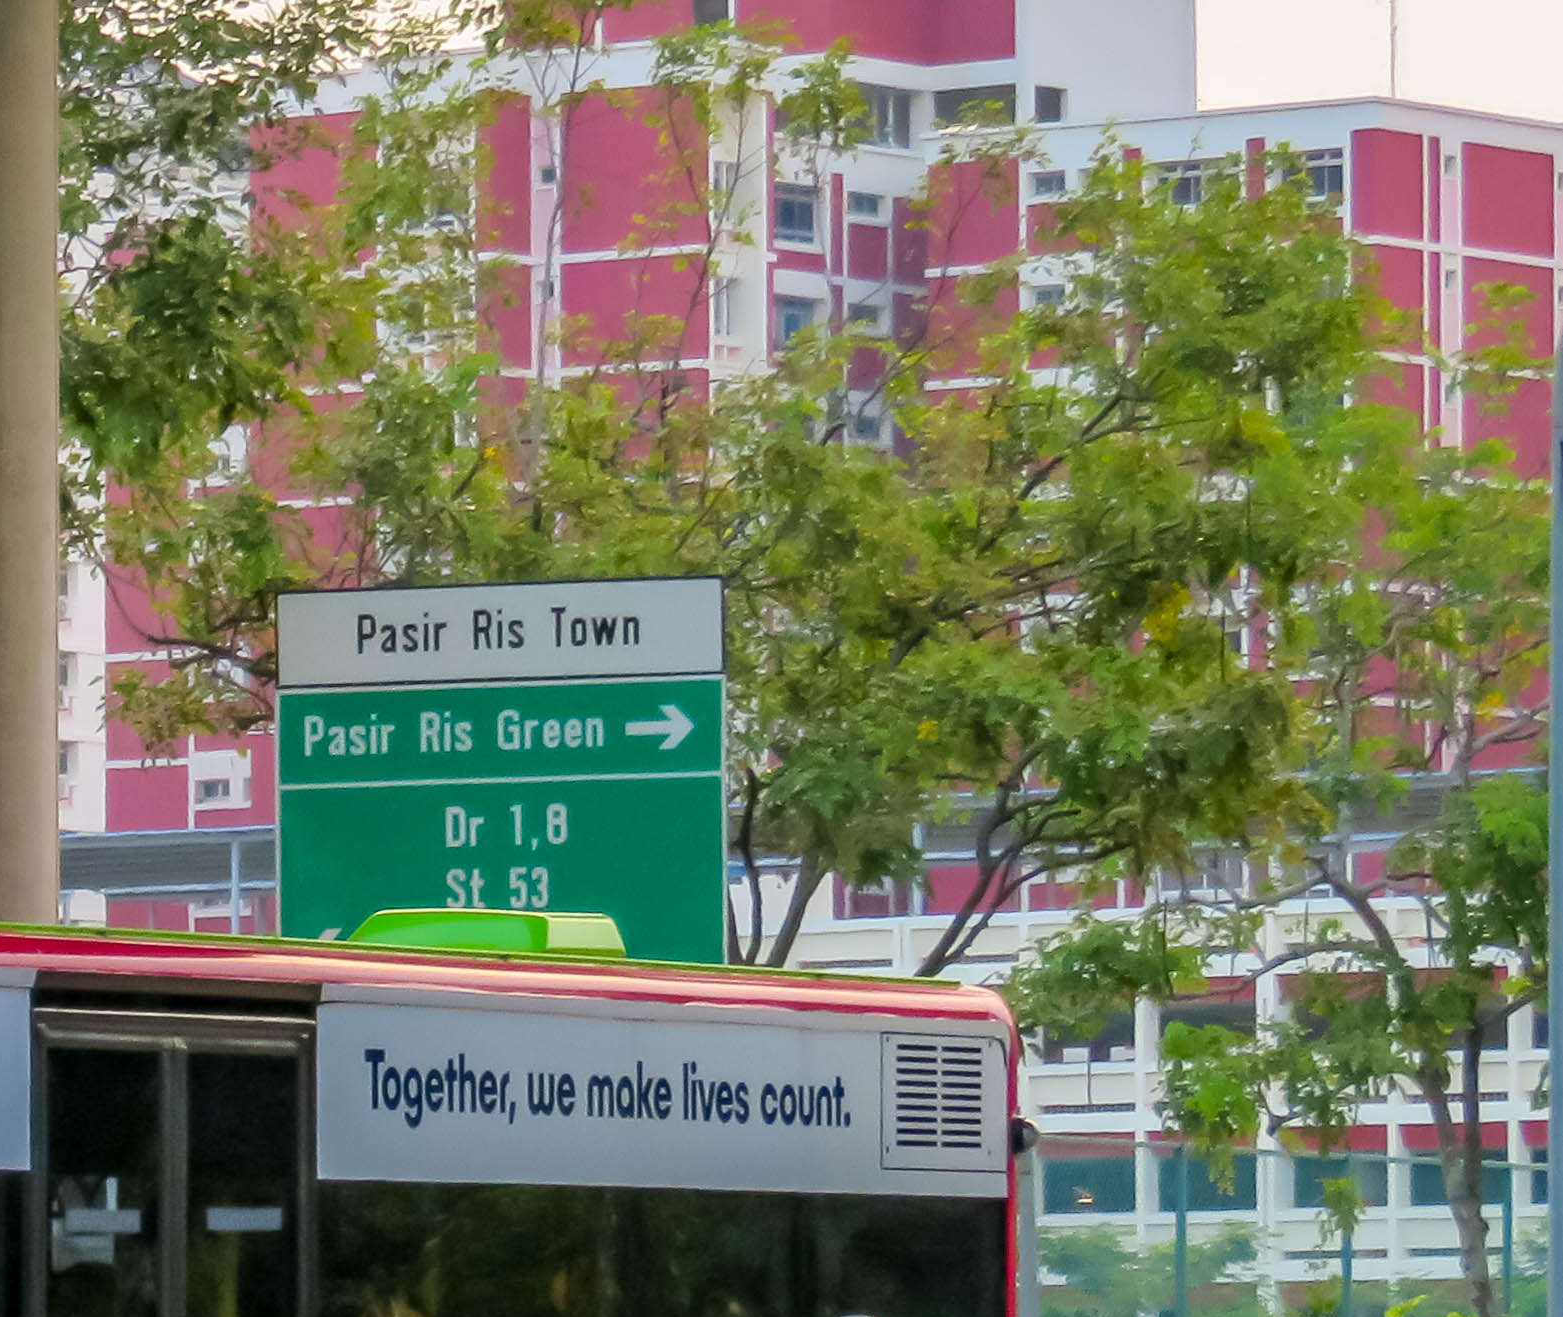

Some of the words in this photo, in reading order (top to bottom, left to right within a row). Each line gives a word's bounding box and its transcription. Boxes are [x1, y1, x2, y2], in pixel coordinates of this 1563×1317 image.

[357, 611, 448, 655] Pasir
[473, 608, 525, 650] Ris
[551, 606, 641, 649] Town
[303, 713, 396, 757] Pasir
[419, 710, 473, 753] Ris
[496, 708, 605, 751] Green
[445, 804, 485, 848] Dr
[509, 802, 569, 851] 1,8
[445, 868, 486, 909] St
[508, 866, 550, 909] 53
[364, 1047, 516, 1129] Together,
[526, 1070, 575, 1117] we
[586, 1060, 672, 1121] make
[682, 1060, 750, 1124] lives
[759, 1075, 852, 1129] count.
